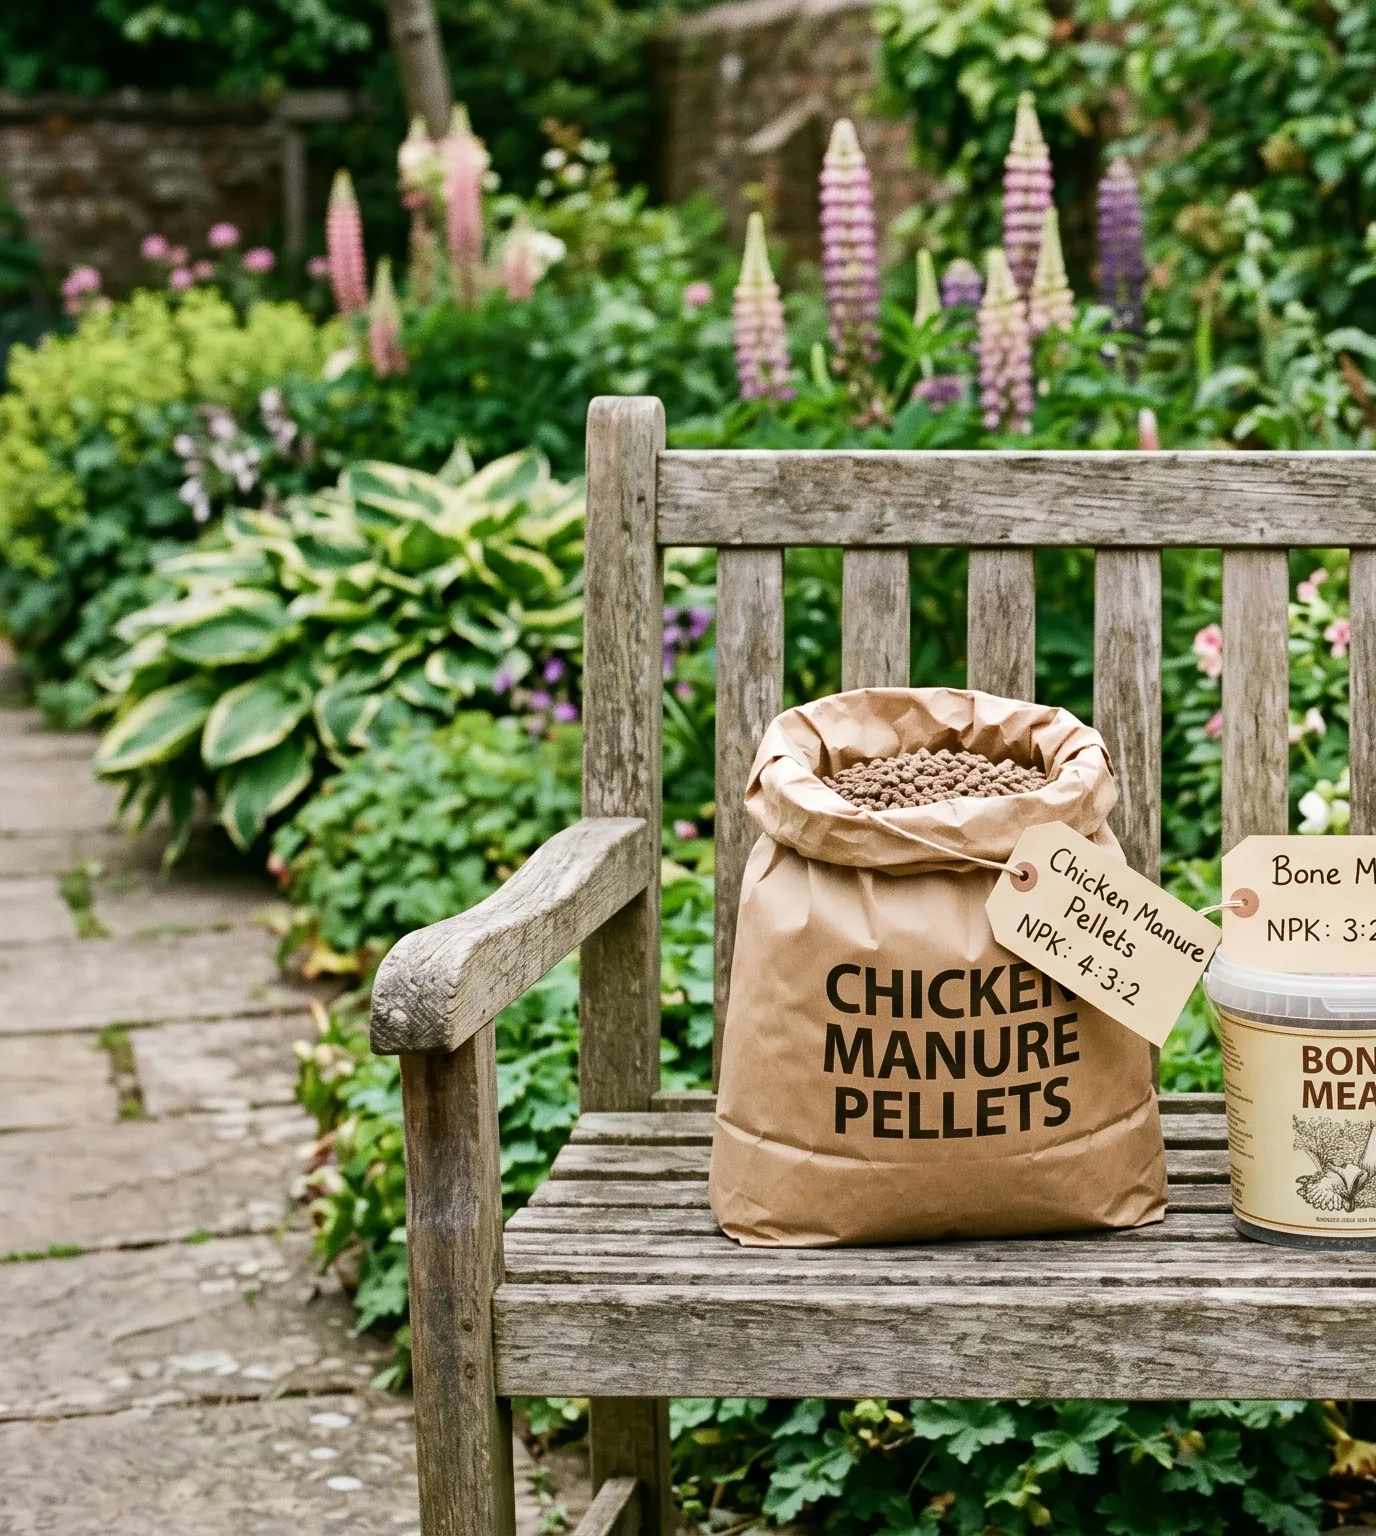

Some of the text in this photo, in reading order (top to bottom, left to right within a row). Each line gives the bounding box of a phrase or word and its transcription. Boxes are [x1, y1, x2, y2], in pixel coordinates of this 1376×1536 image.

[1271, 854, 1341, 886] Bone
[1049, 848, 1205, 963] Chicken Manure
[1063, 895, 1136, 958] Pellets
[1266, 918, 1331, 942] NPK:
[1016, 913, 1140, 1007] NPK: 4:3:2
[823, 1011, 1080, 1080] MANURE
[834, 1076, 1072, 1140] PELLETS
